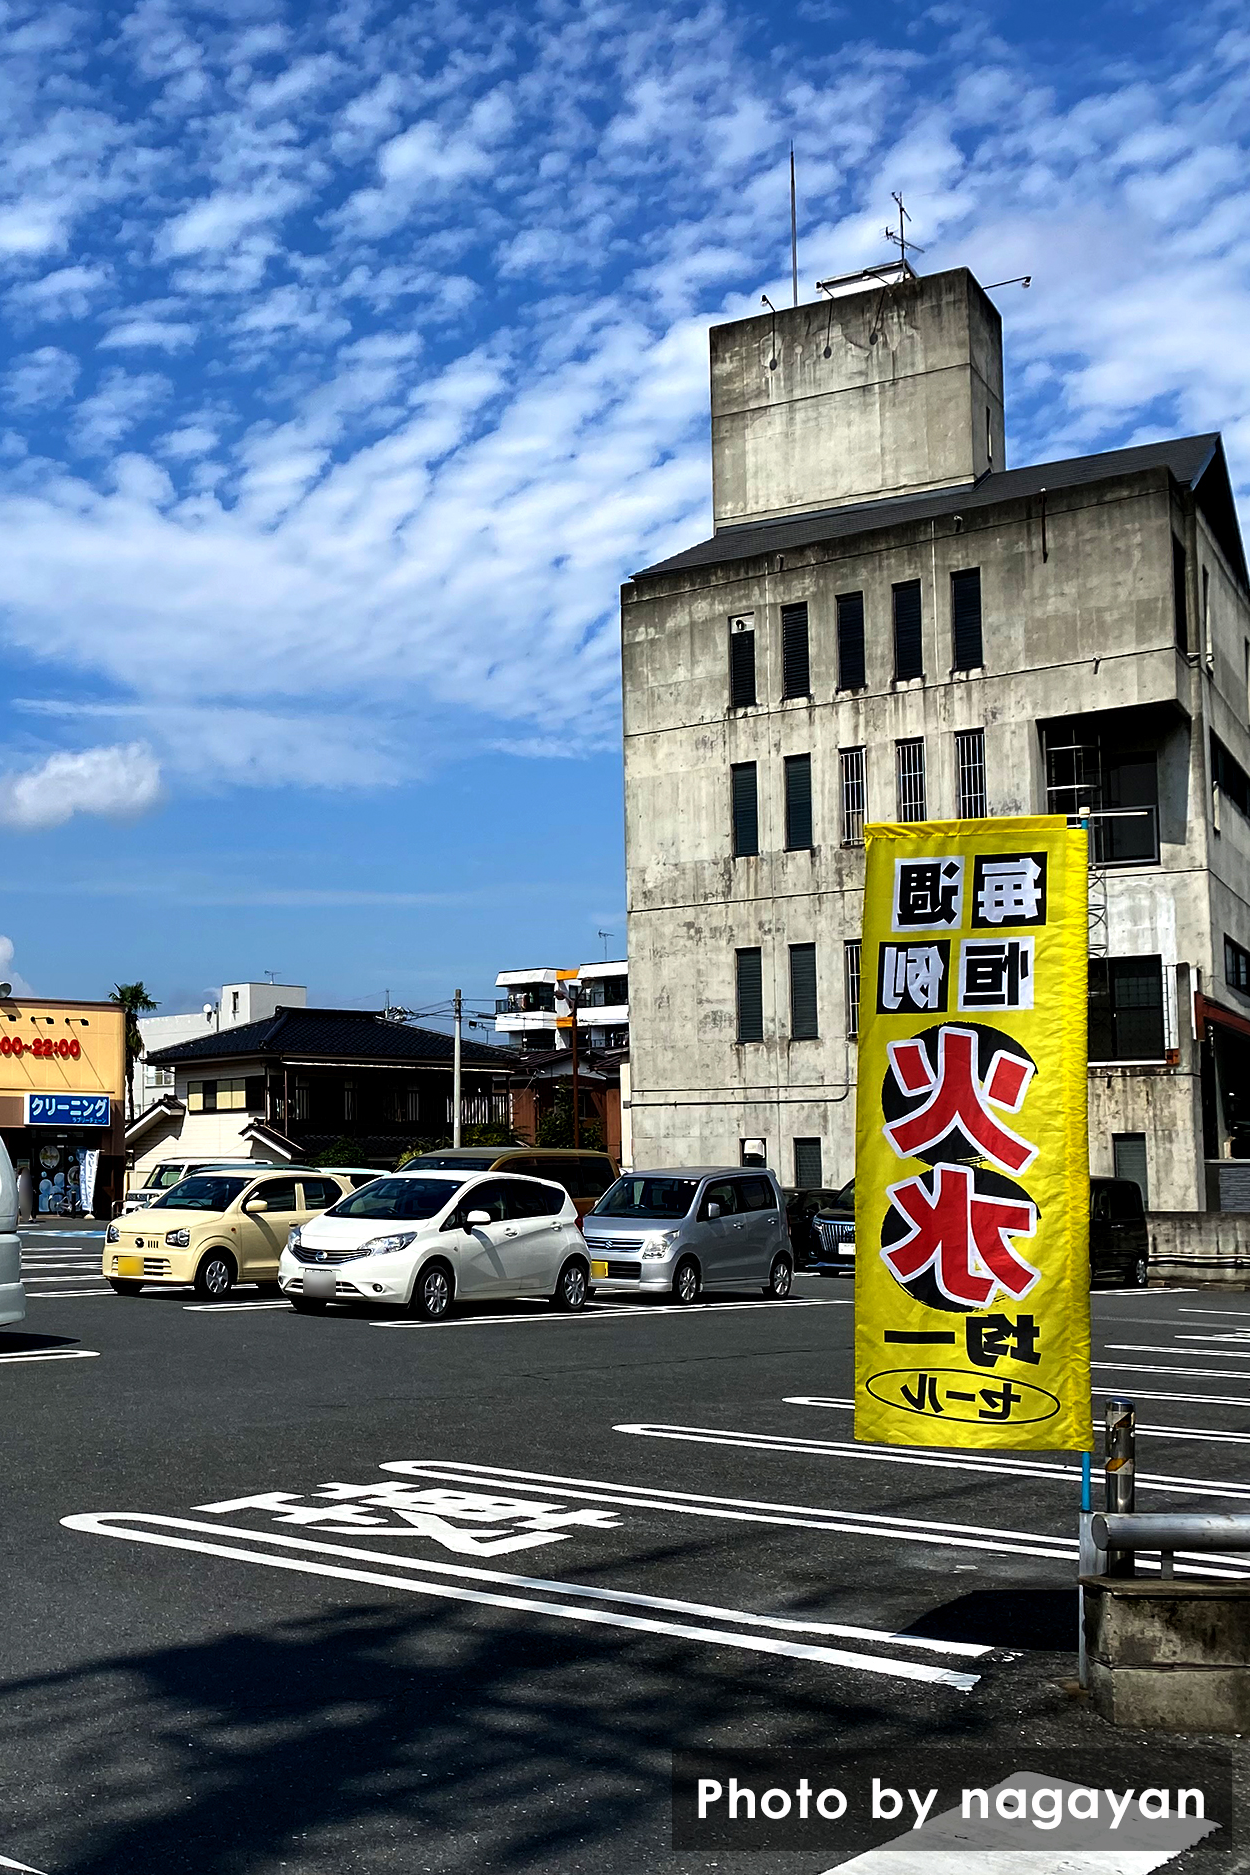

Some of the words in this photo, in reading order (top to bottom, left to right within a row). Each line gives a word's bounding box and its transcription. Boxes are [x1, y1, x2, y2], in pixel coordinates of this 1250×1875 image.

[31, 1097, 108, 1117] クリーニング
